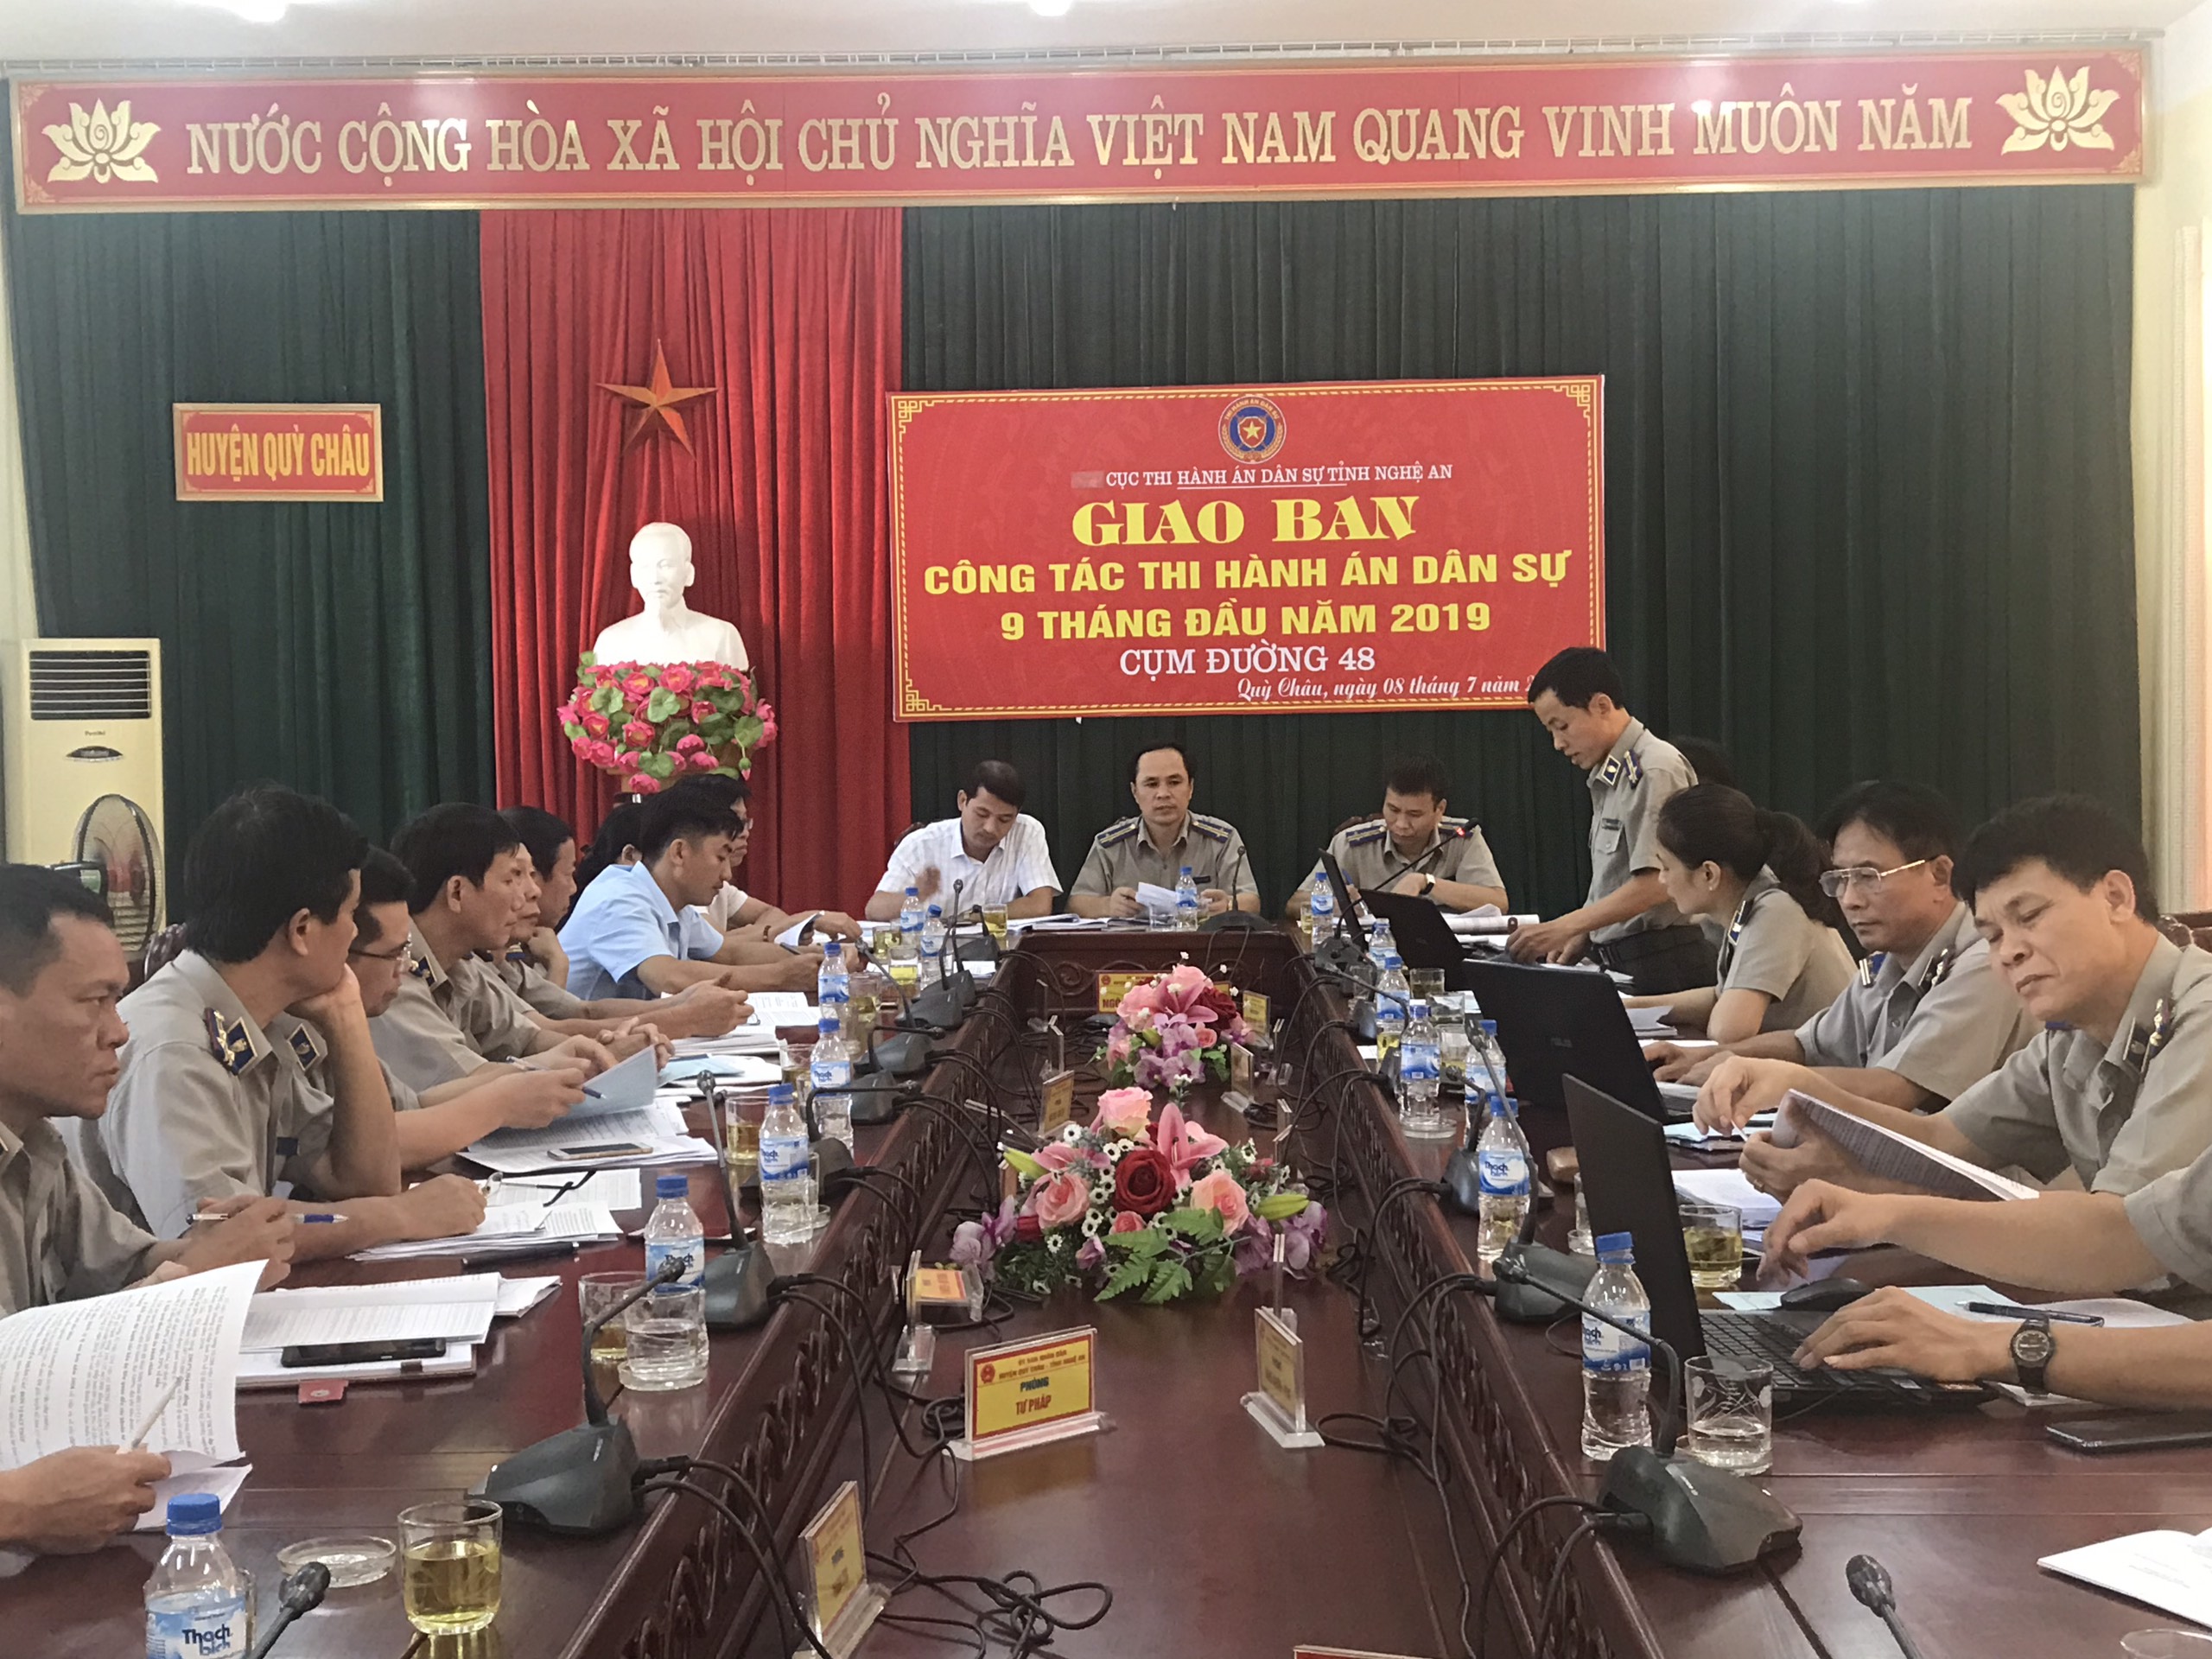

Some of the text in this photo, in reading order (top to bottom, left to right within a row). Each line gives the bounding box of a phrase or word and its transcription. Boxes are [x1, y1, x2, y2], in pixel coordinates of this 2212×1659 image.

[186, 82, 1974, 188] NƯỚC CỘNG HÒA XÃ HỘI CHỦ NGHĨA VIỆT NAM QUANG VINH MUÔN NĂM
[187, 423, 370, 482] HUYỆN QUỲ CHÂU
[1106, 471, 1139, 490] CỤC
[1142, 471, 1173, 486] THI
[1177, 466, 1227, 485] HÀNH
[1231, 463, 1256, 484] ÁN
[1260, 464, 1298, 484] DÂN
[1302, 466, 1325, 487] SỰ
[1327, 461, 1370, 482] TỈNH
[1374, 461, 1423, 484] NGHỆ
[1427, 464, 1452, 480] AN
[1071, 496, 1420, 545] GIAO BAN
[924, 549, 1573, 594] CÔNG TÁC THI HÀNH ÁN DÂN SỰ
[1001, 598, 1491, 640] 9 THÁNG ĐẦU NĂM 2019
[1120, 639, 1376, 681] CỤM ĐƯỜNG 48
[1236, 677, 1273, 702] Quỳ
[1277, 677, 1329, 700] Châu,
[1333, 677, 1377, 701] ngày
[1382, 677, 1405, 696] 08
[1409, 674, 1460, 699] tháng
[1467, 676, 1478, 693] 7
[1481, 675, 1519, 693] năm
[1020, 1376, 1049, 1392] PHÒNG
[1028, 1393, 1052, 1413] PHÁP
